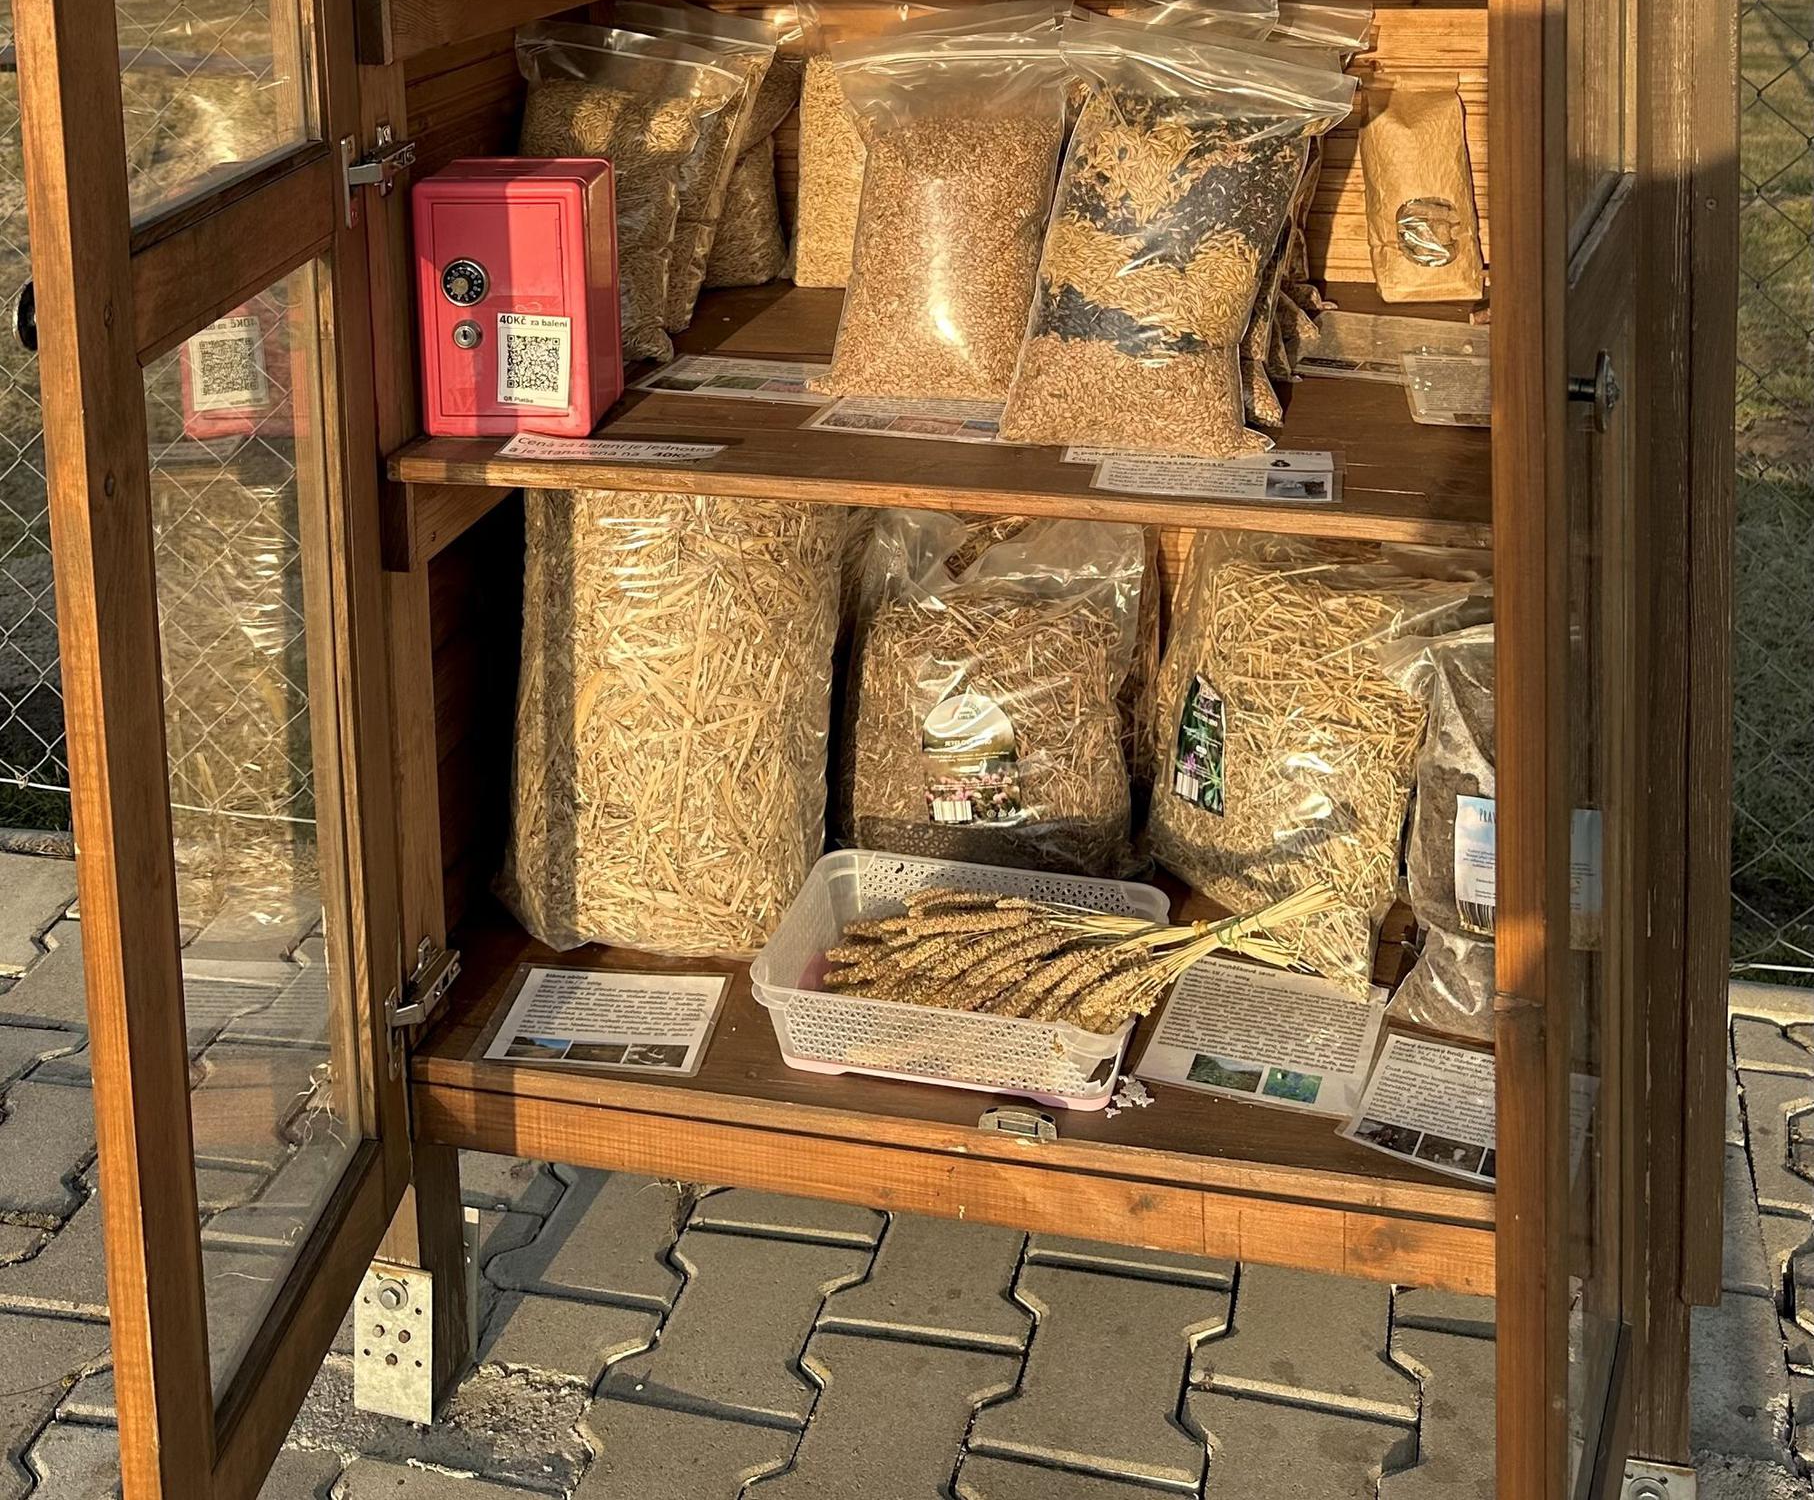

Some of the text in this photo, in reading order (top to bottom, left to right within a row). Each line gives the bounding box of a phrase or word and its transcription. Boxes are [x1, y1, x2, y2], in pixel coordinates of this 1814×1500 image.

[499, 314, 526, 325] 40Kč
[541, 318, 568, 328] balení
[518, 436, 555, 447] Cena
[558, 441, 576, 449] za
[579, 440, 626, 450] balení
[627, 443, 643, 451] je
[520, 447, 536, 455] je
[539, 449, 617, 458] stanovena
